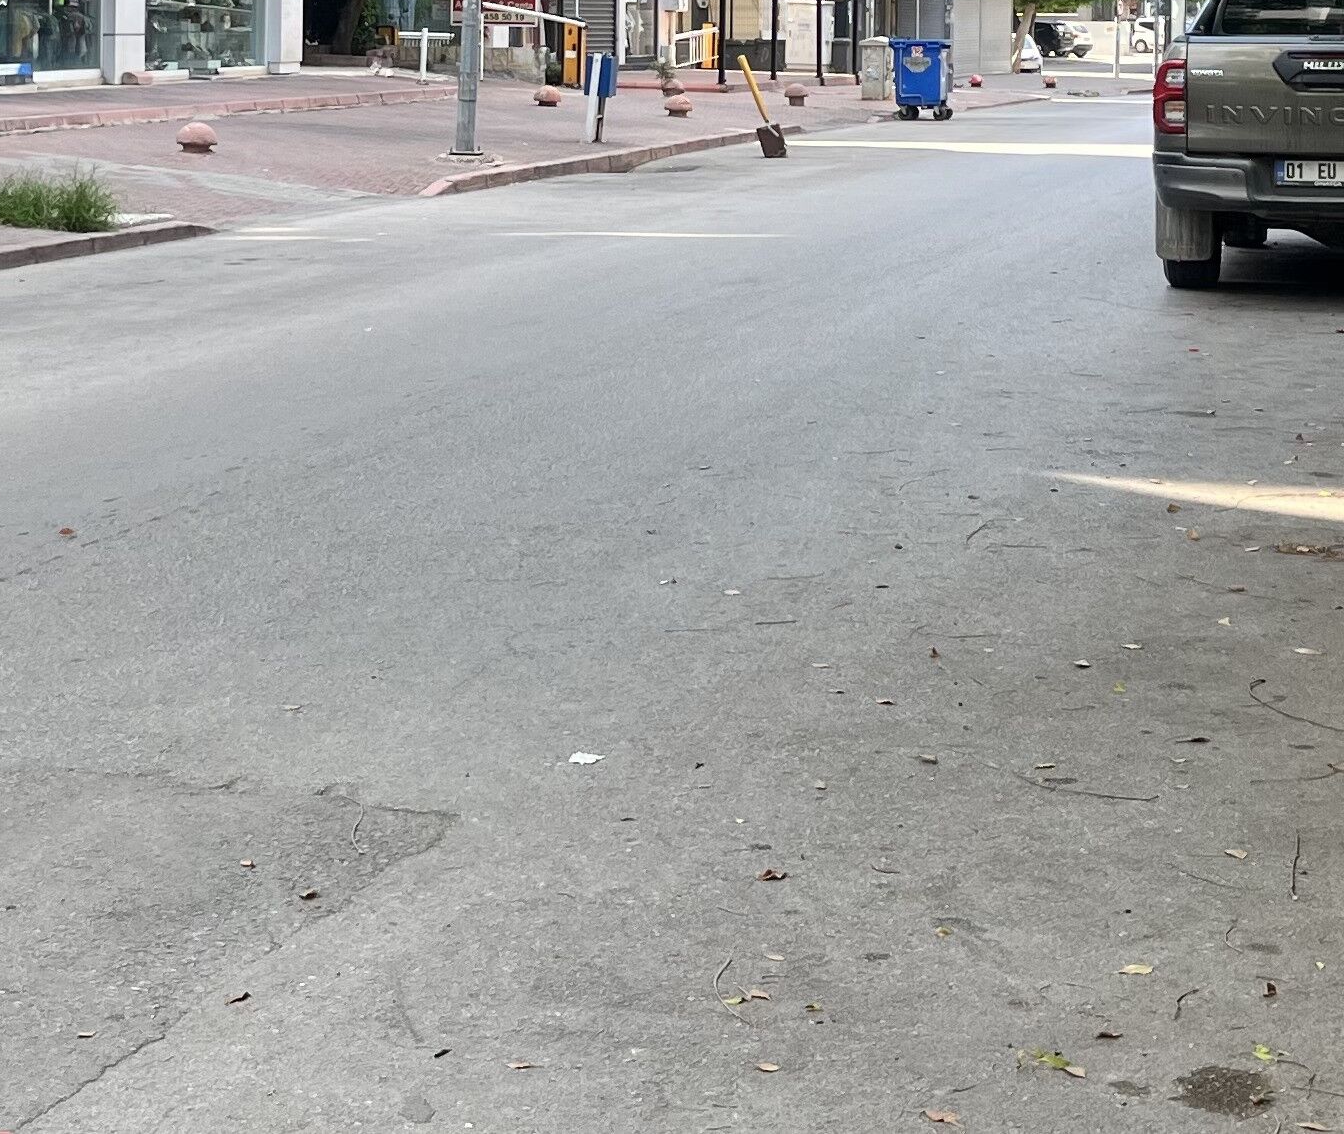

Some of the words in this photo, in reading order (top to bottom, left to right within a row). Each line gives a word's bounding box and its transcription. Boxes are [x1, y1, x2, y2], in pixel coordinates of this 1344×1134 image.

[501, 13, 513, 22] 50
[514, 14, 525, 22] 19
[1286, 162, 1304, 179] 01
[1317, 162, 1337, 180] EU
